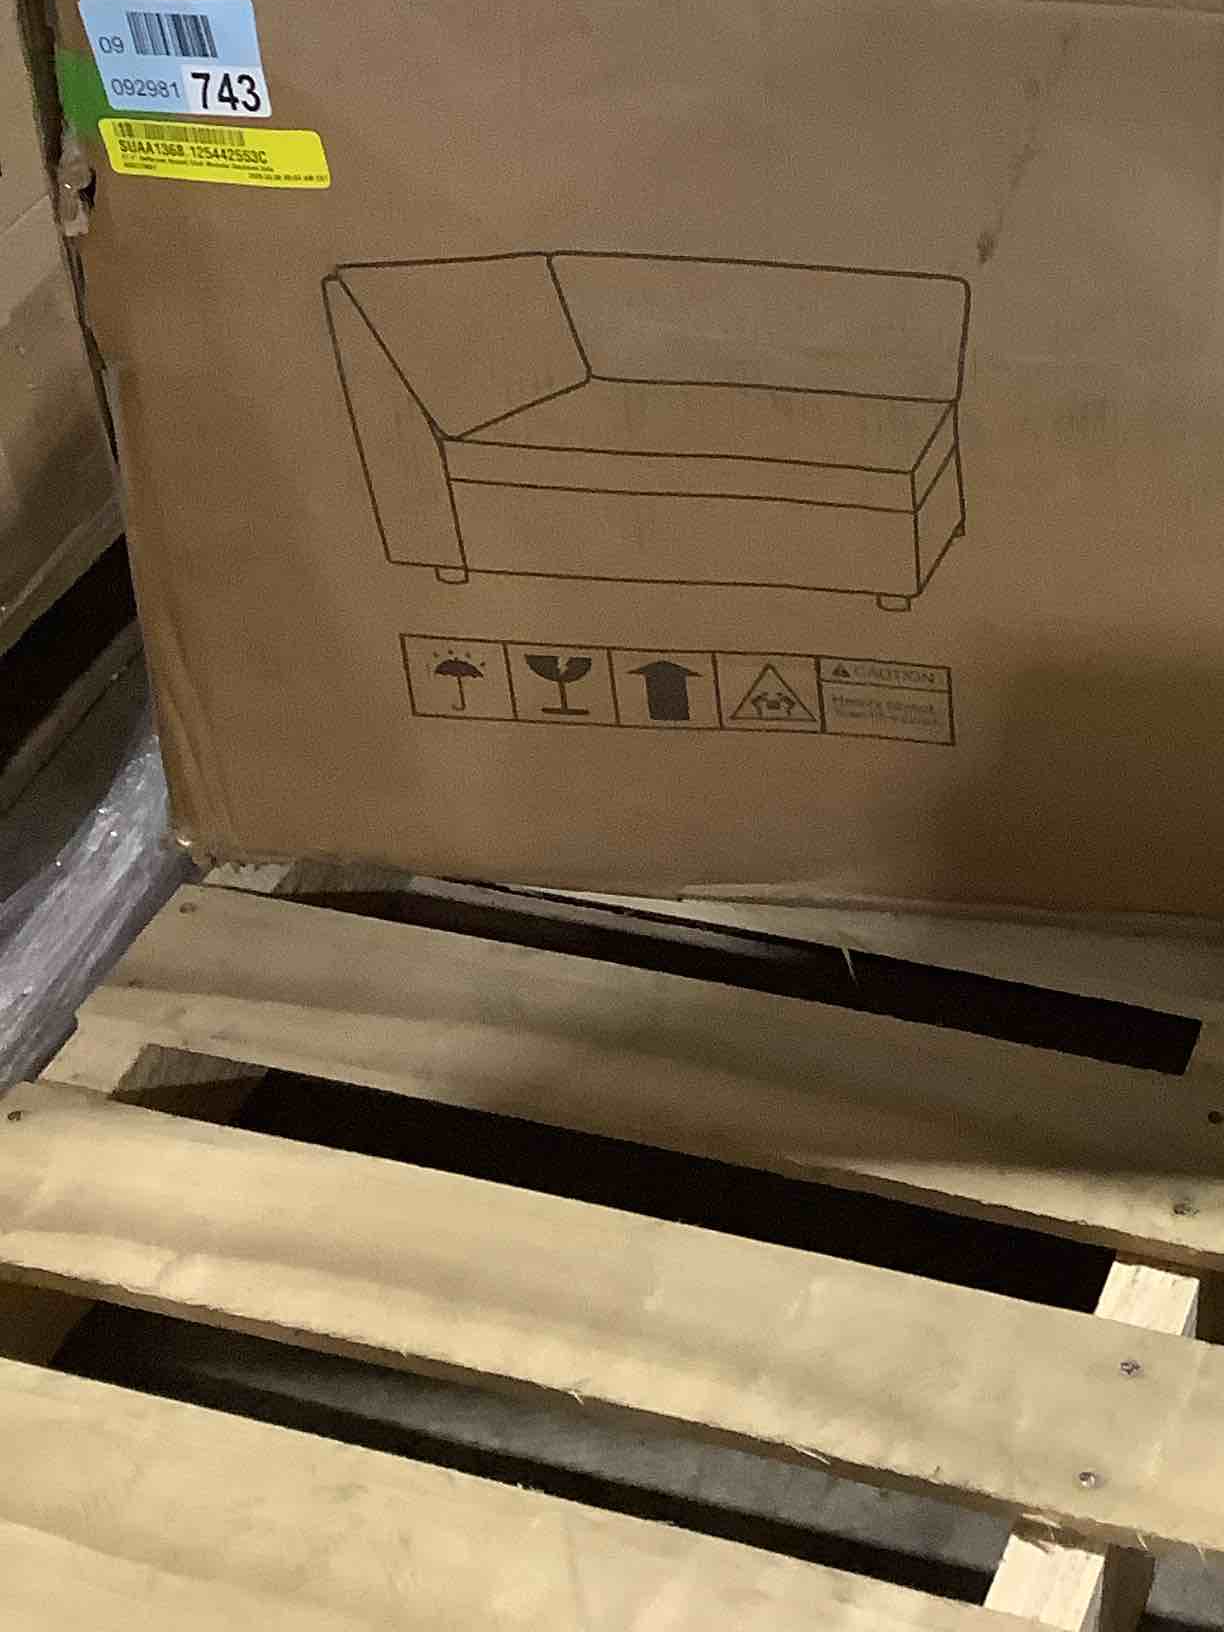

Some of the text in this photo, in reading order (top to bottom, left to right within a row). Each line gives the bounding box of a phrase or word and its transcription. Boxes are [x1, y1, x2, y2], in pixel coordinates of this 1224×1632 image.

[99, 36, 125, 54] 09
[111, 71, 262, 112] 092981 743
